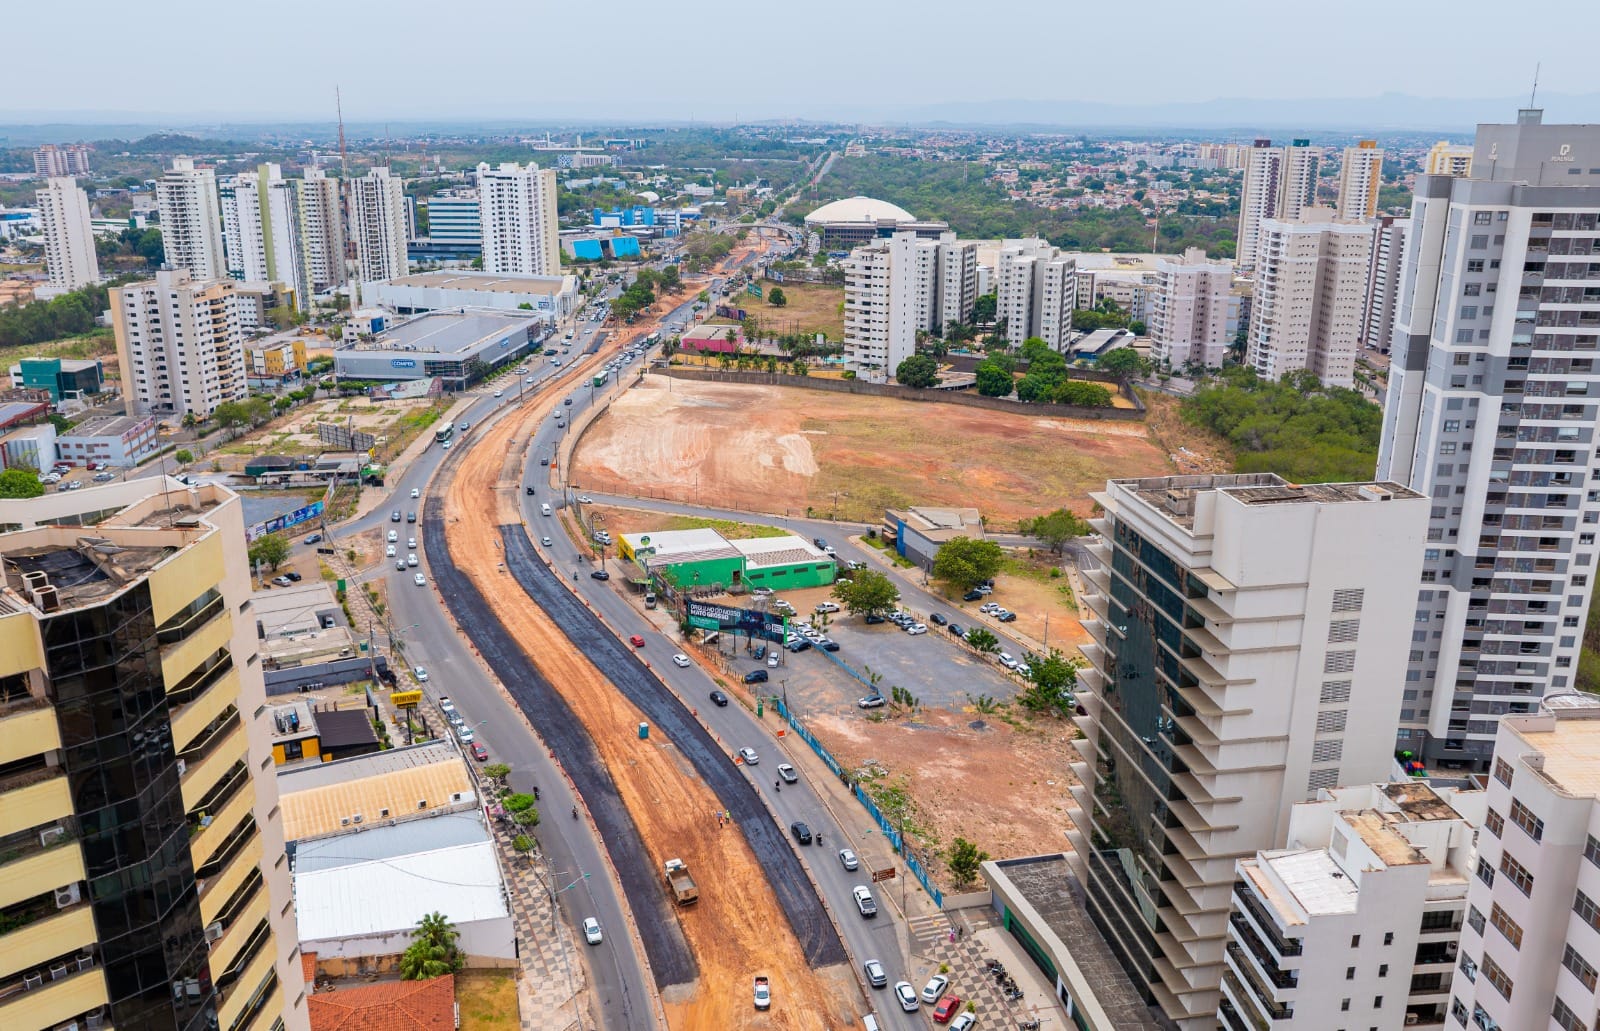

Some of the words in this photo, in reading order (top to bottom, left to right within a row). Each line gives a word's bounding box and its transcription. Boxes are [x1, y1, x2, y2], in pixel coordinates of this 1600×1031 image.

[690, 609, 706, 617] MATO
[706, 611, 729, 620] GROSSO
[723, 609, 741, 617] NOSSO
